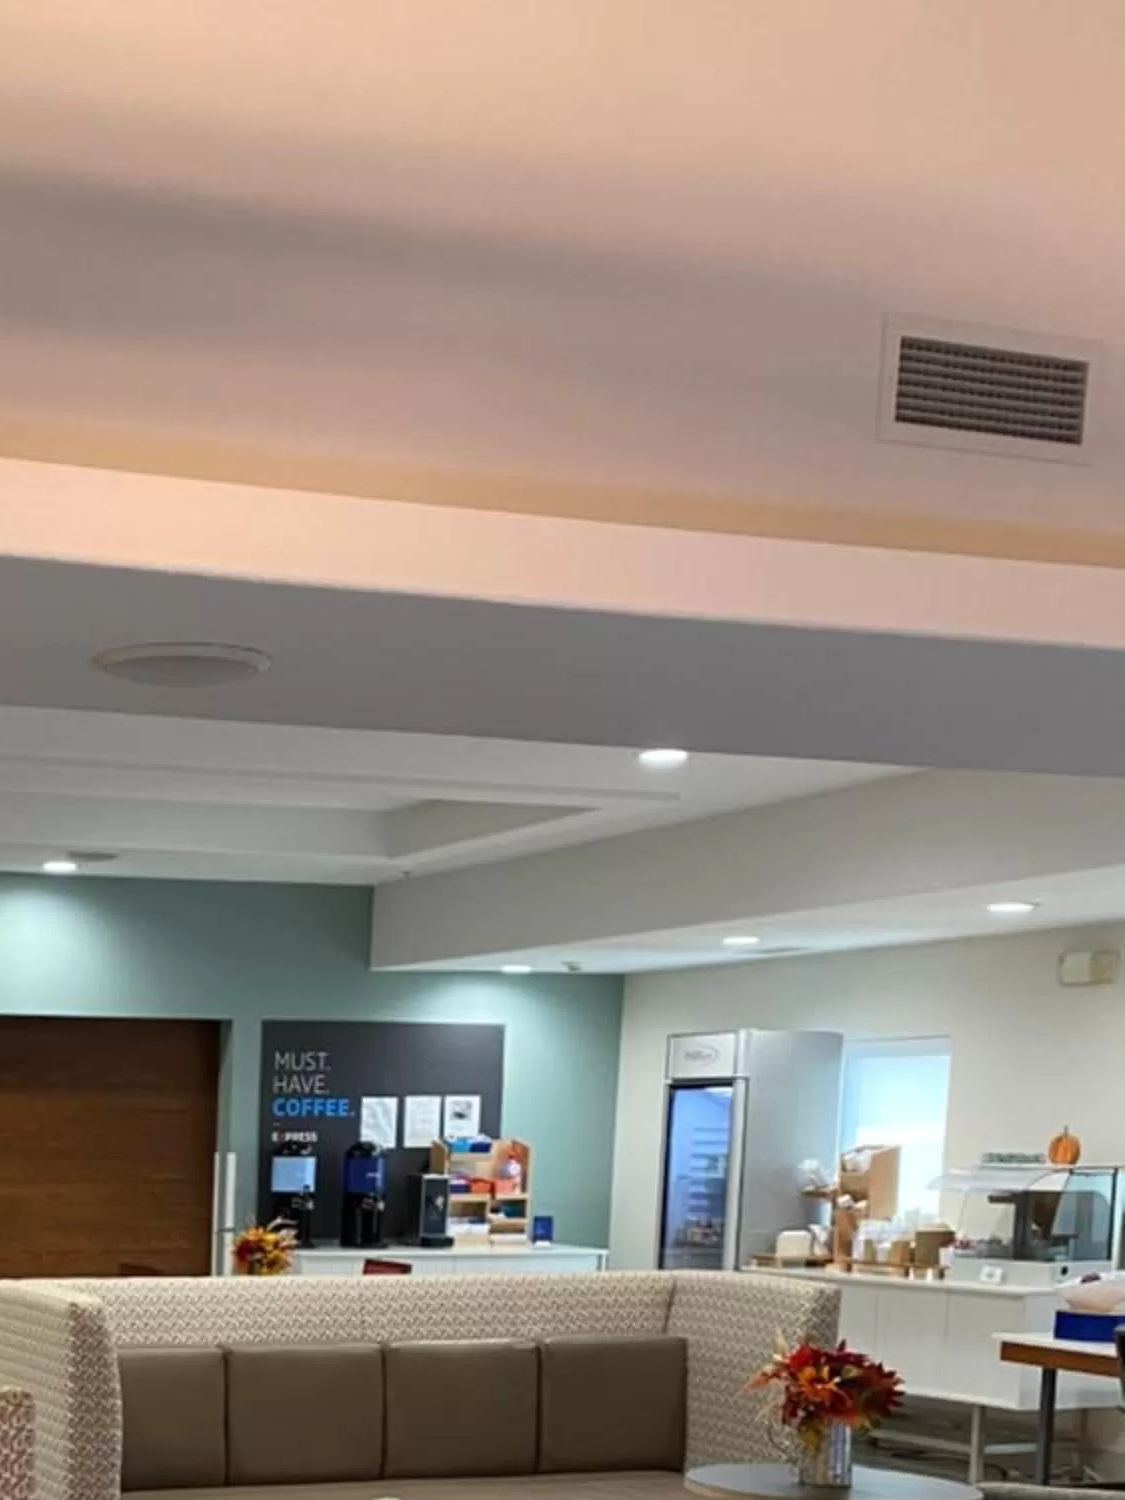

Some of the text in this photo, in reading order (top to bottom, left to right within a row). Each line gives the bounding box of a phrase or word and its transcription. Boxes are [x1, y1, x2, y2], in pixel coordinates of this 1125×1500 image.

[274, 1051, 331, 1071] MUST.
[273, 1074, 330, 1094] HAVE.
[271, 1097, 355, 1117] COFFEE.
